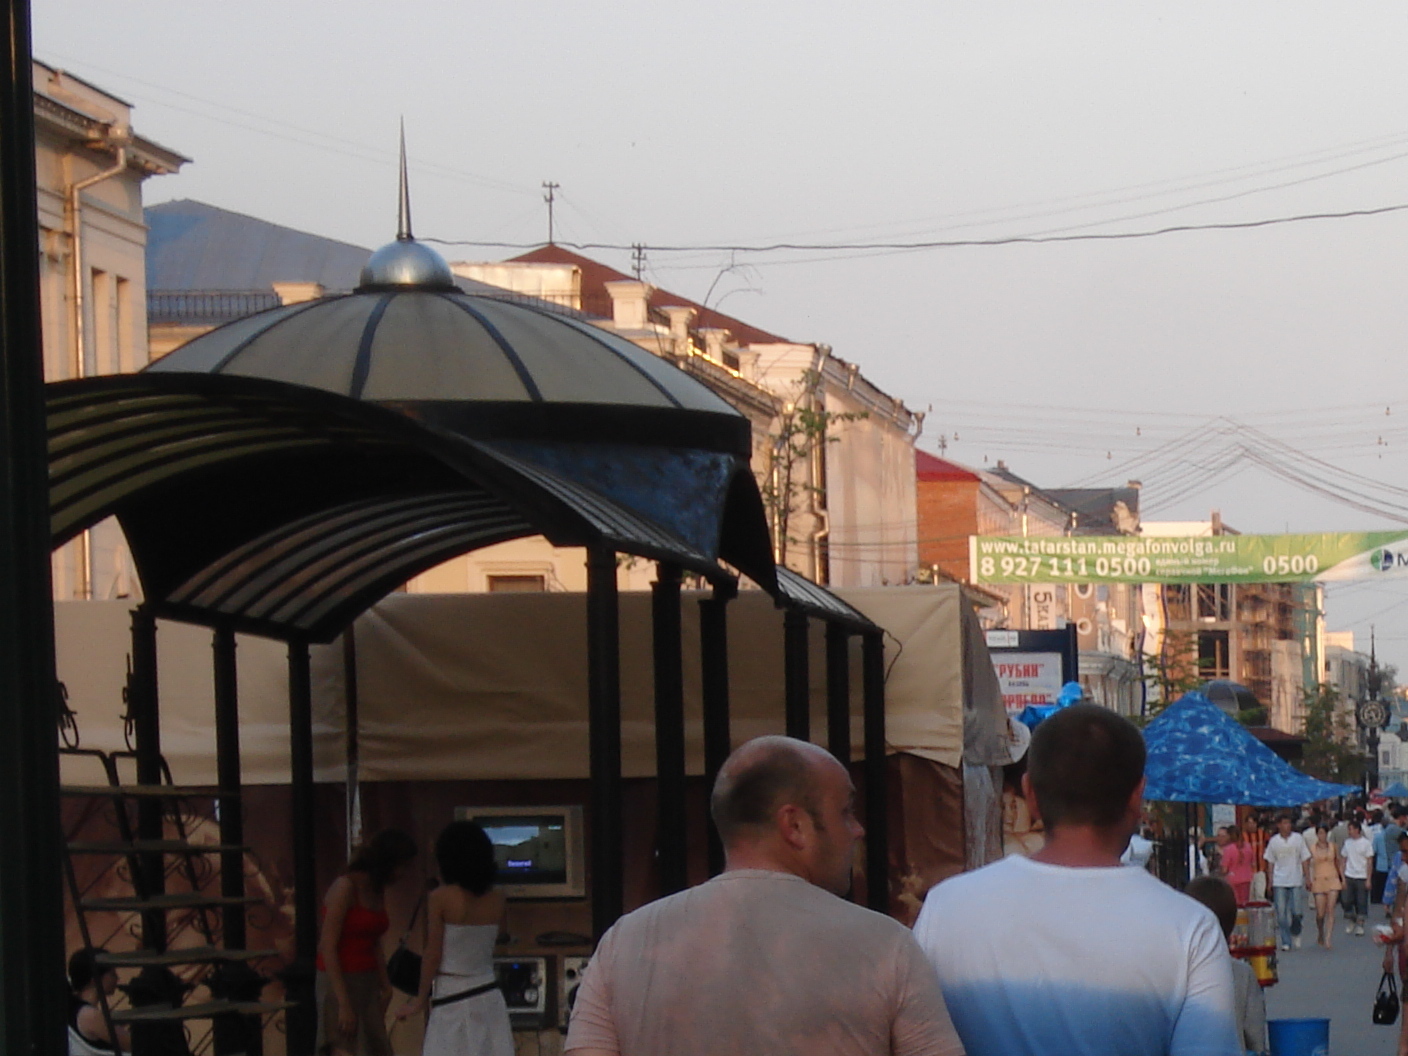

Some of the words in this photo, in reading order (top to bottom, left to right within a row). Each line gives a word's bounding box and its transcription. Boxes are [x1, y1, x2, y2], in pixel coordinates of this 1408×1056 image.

[981, 538, 1236, 557] www.tatarstan.megafonvolga.ru
[980, 557, 995, 576] 8
[1001, 557, 1042, 576] 927
[1049, 557, 1089, 576] 111
[1095, 557, 1151, 577] 0500
[1262, 555, 1319, 576] 0500
